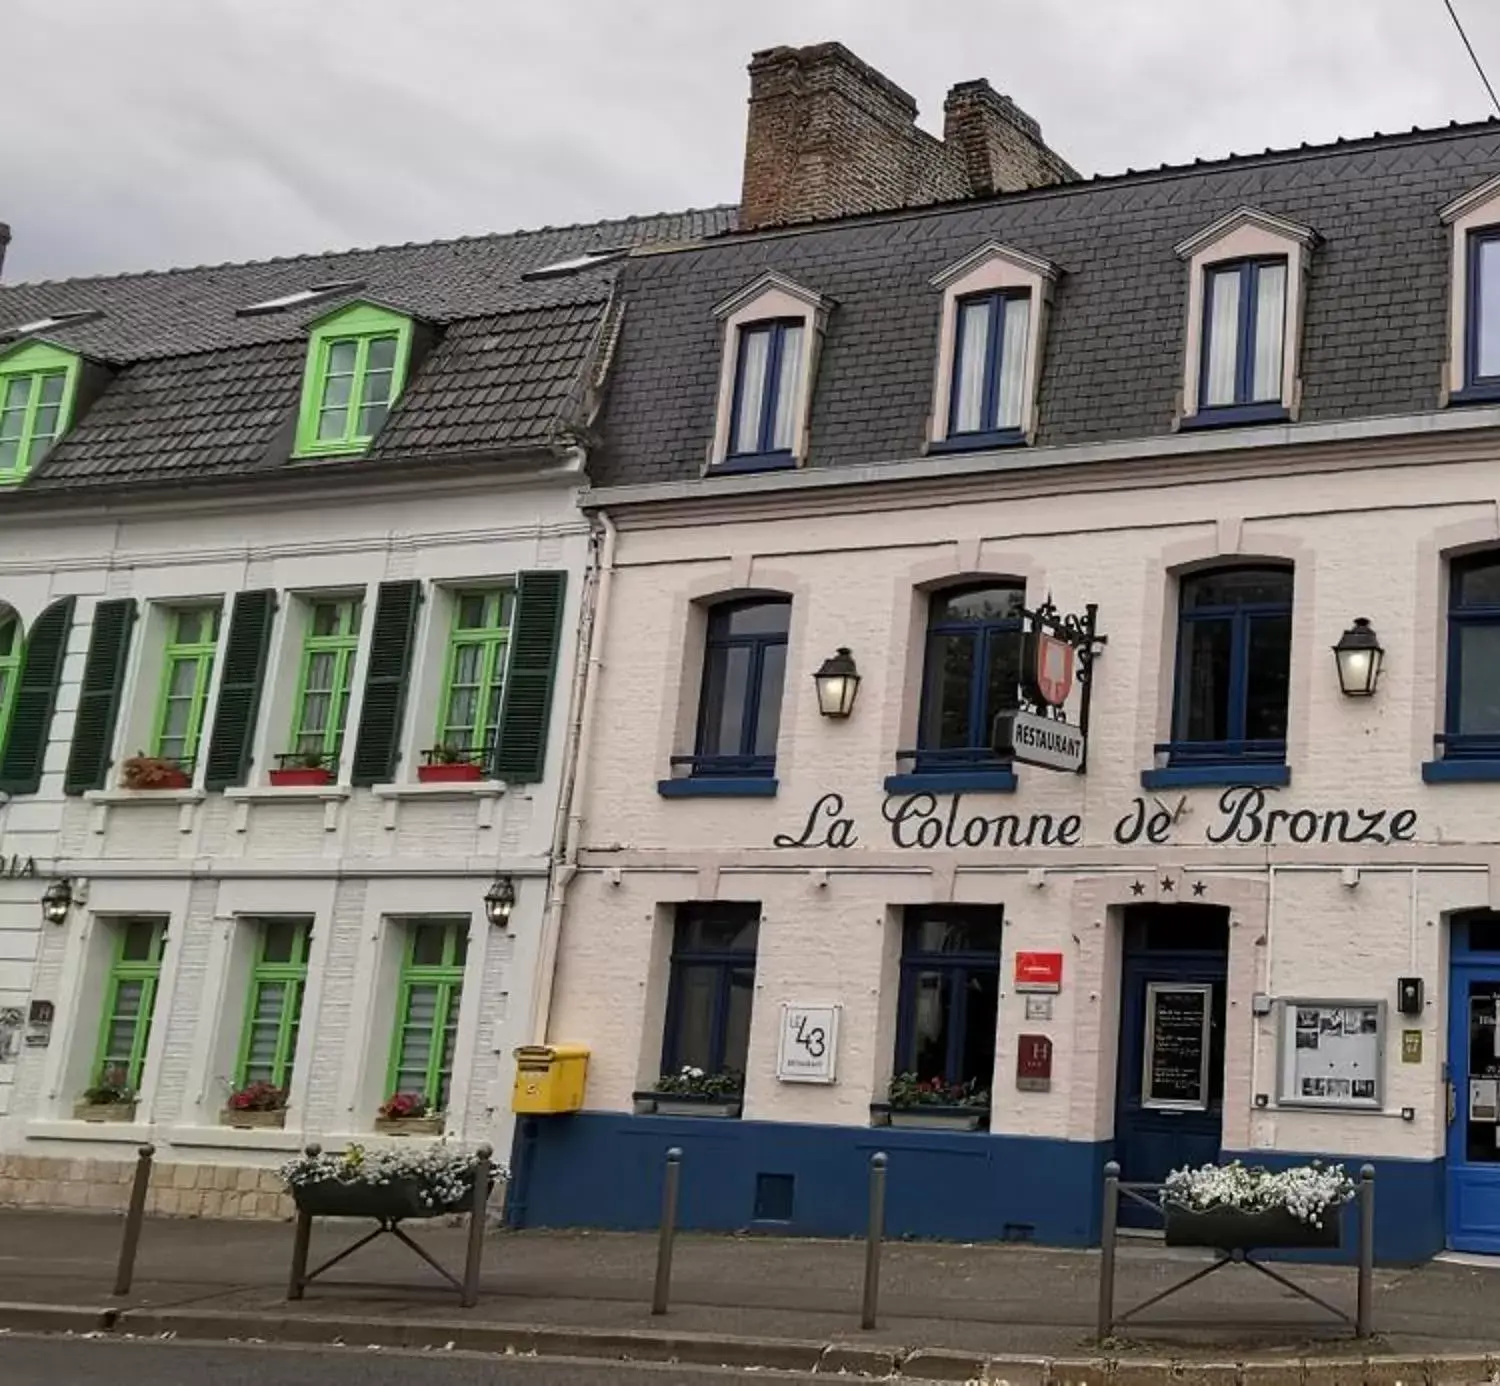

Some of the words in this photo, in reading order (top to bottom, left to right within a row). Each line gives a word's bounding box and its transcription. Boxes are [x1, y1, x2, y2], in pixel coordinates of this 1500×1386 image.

[1016, 724, 1081, 759] RESTAURANT
[773, 793, 858, 849] La
[881, 792, 1082, 849] Colonne
[1114, 797, 1171, 844] de
[1206, 785, 1418, 844] Bronze
[796, 1016, 825, 1057] 43
[1033, 1043, 1047, 1059] H
